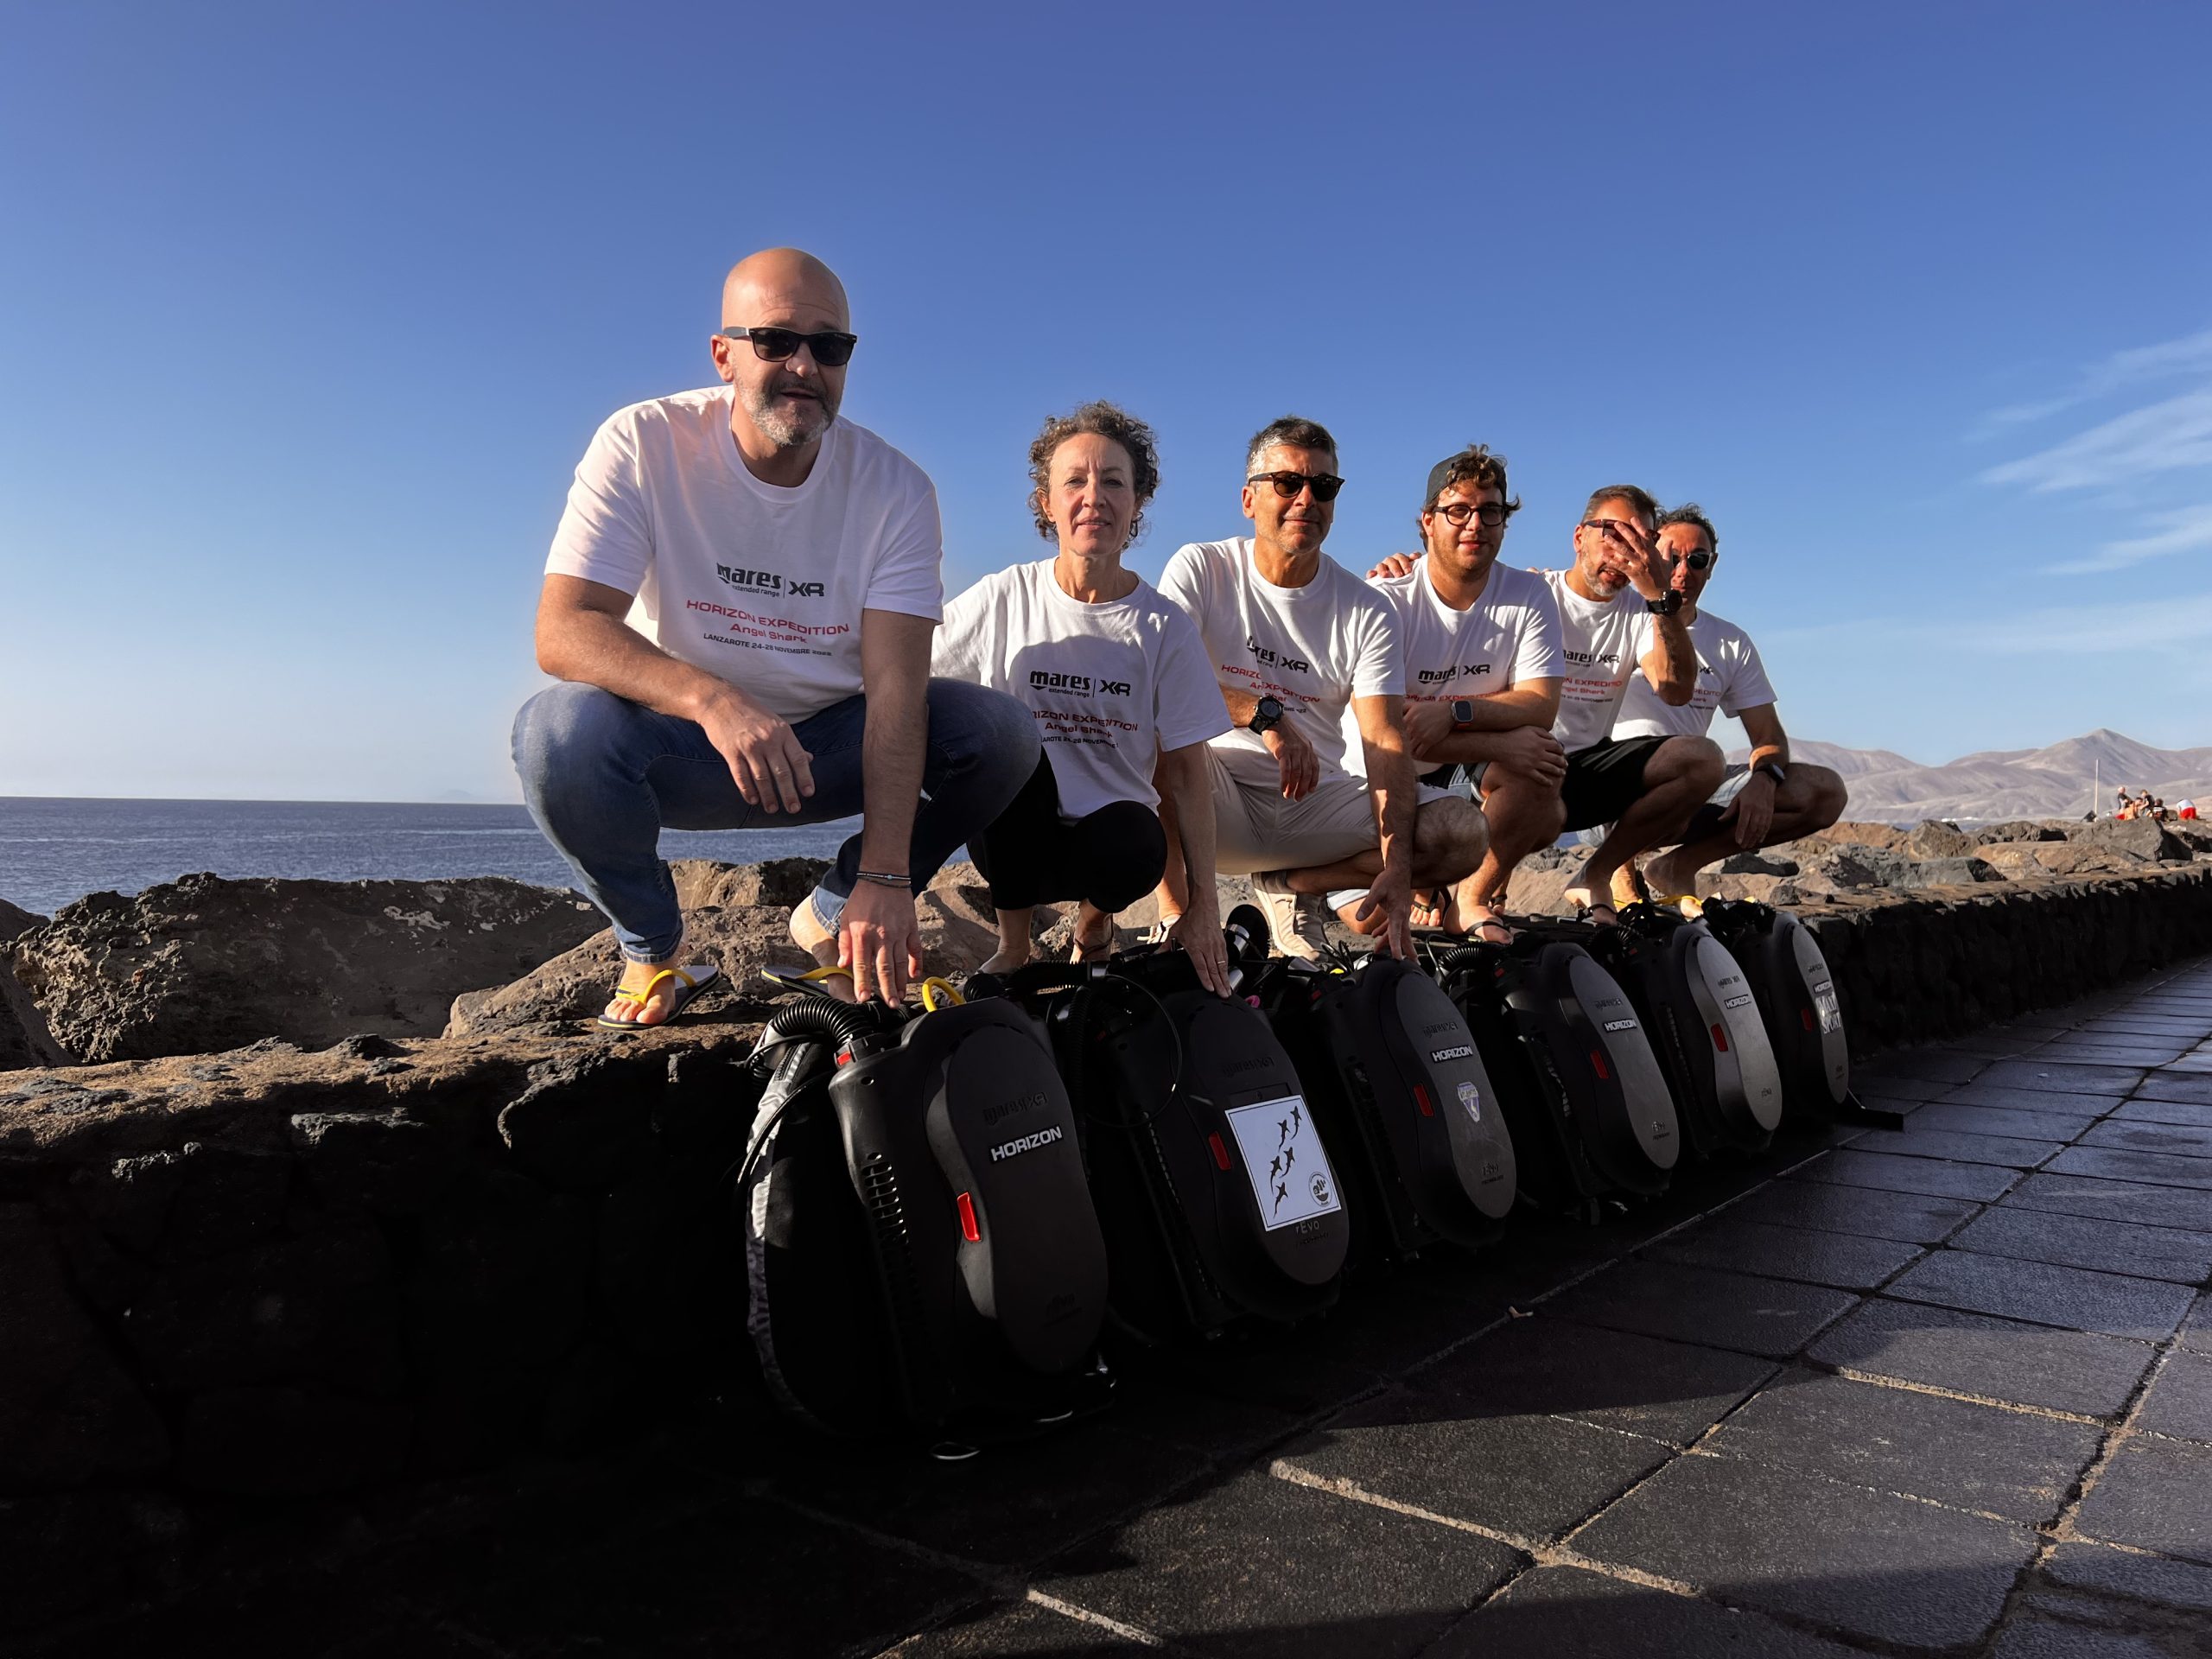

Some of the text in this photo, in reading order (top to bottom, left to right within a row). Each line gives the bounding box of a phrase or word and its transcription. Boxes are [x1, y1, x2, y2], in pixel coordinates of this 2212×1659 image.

[716, 563, 824, 597] mares XR
[732, 585, 780, 598] extended range
[687, 600, 849, 635] HORIZON EXPEDITION
[703, 633, 750, 648] LANZAROTE
[730, 623, 807, 643] Angel Shark
[1281, 657, 1309, 673] XR
[1464, 664, 1491, 676] XR
[1030, 671, 1131, 696] mares XR
[1049, 688, 1073, 696] extended
[1045, 722, 1077, 733] Angel
[1604, 1020, 1637, 1032] HORIZON
[1432, 1046, 1473, 1062] HORIZON
[990, 1126, 1063, 1161] HORIZON
